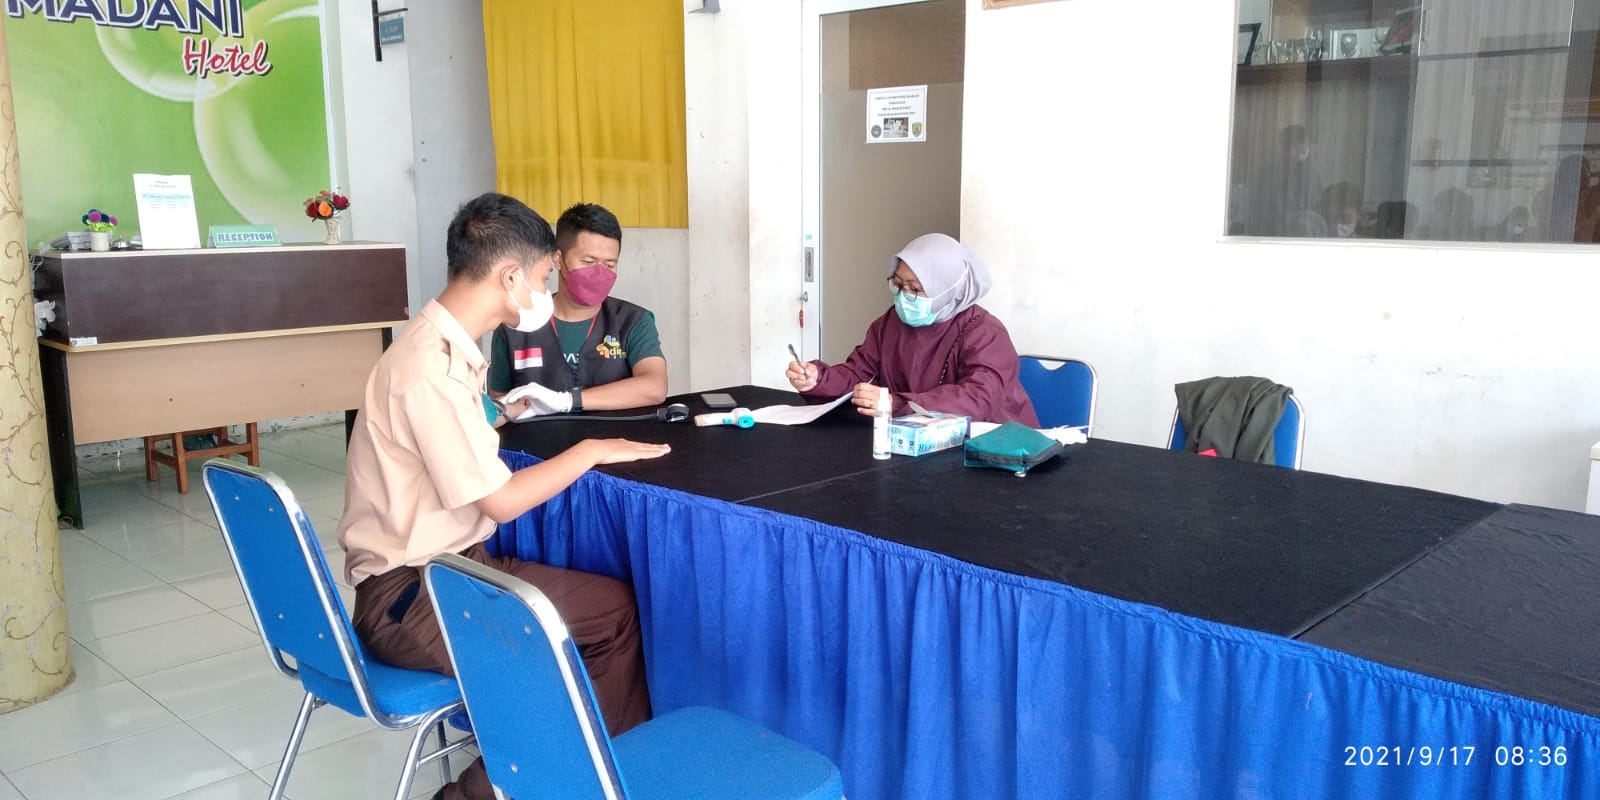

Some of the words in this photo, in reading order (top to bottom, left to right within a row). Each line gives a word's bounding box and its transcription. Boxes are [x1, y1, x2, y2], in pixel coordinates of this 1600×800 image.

[8, 0, 244, 36] MADANI
[183, 38, 271, 77] Hotel
[217, 232, 273, 242] RECEPTION
